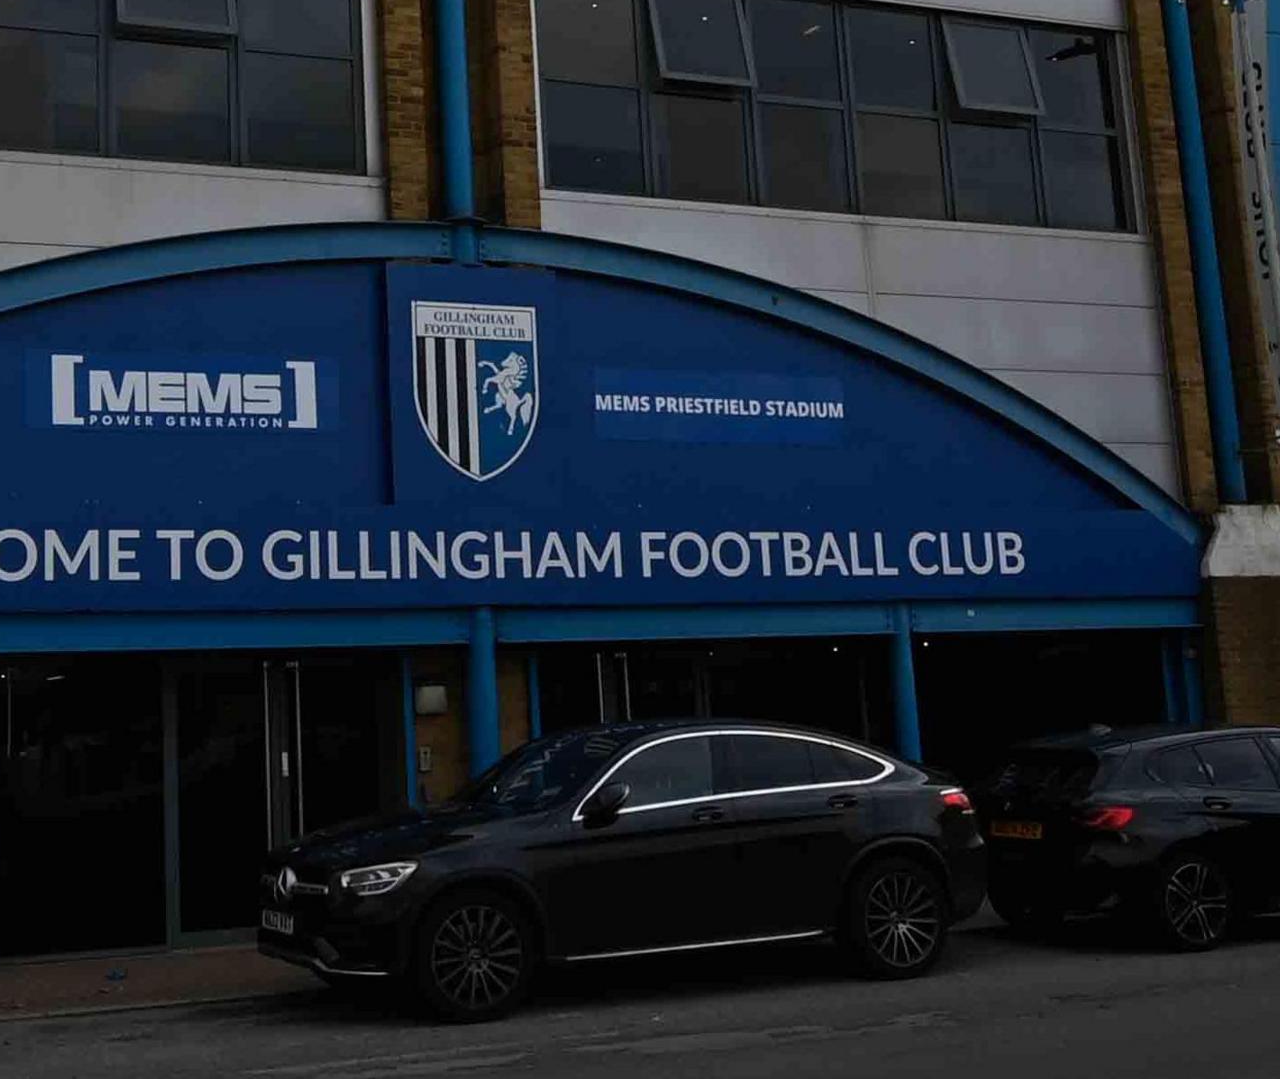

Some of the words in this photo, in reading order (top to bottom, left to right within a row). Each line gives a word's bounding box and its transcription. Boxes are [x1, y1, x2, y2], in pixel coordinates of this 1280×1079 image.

[433, 311, 515, 325] GILLINGHAM
[424, 324, 489, 337] FOOTBALL
[493, 327, 527, 338] CLUB
[89, 370, 282, 414] MEMS
[595, 394, 650, 412] MEMS
[655, 396, 761, 416] PRIESTFIELD
[765, 400, 844, 419] STADIUM
[89, 415, 153, 426] POWER
[166, 416, 283, 428] GENERATION
[156, 530, 243, 580] TO
[263, 529, 622, 580] GILLINGHAM
[640, 531, 898, 578] FOOTBALL
[908, 531, 1025, 575] CLUB
